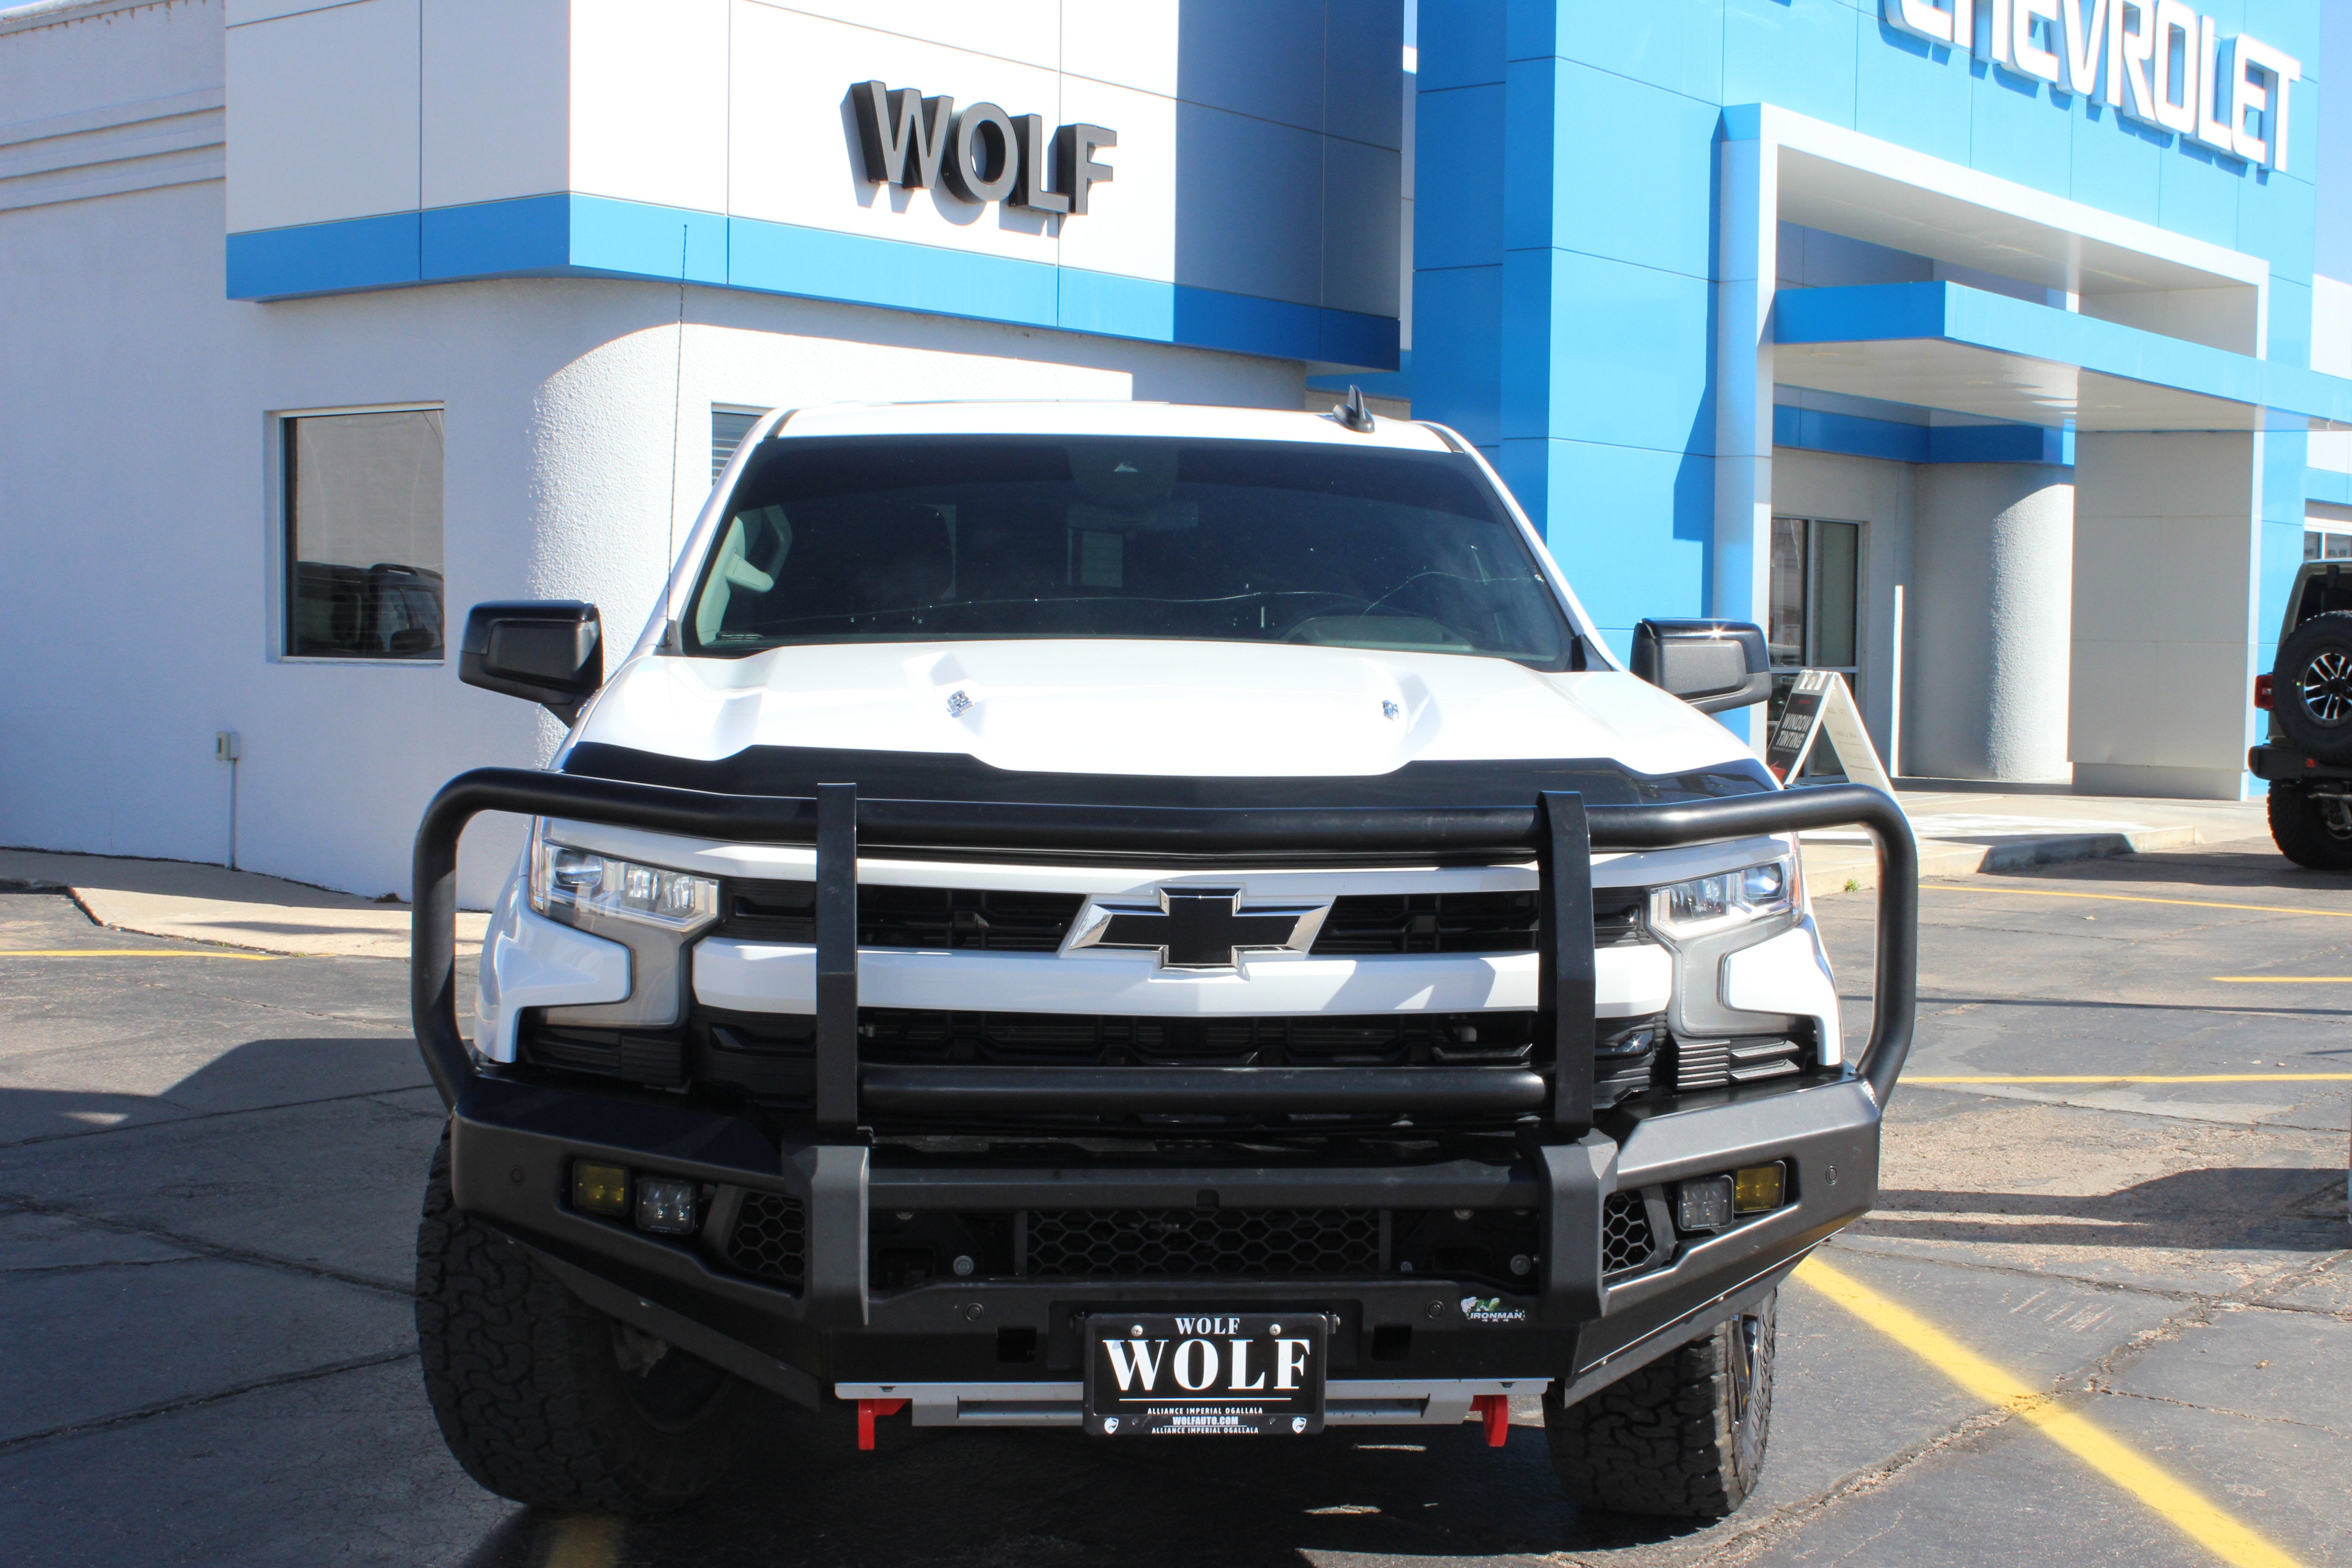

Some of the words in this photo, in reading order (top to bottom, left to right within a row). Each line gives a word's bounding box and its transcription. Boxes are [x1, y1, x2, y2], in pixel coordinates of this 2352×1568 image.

[1896, 0, 2301, 172] EVROLET
[858, 80, 1117, 215] WOLF
[1781, 713, 1813, 732] WINDOW
[1776, 730, 1805, 749] TINTING
[1175, 1318, 1240, 1334] WOLF
[1102, 1338, 1310, 1391] WOLF
[1172, 1416, 1239, 1425] WOLFAUTO.COM
